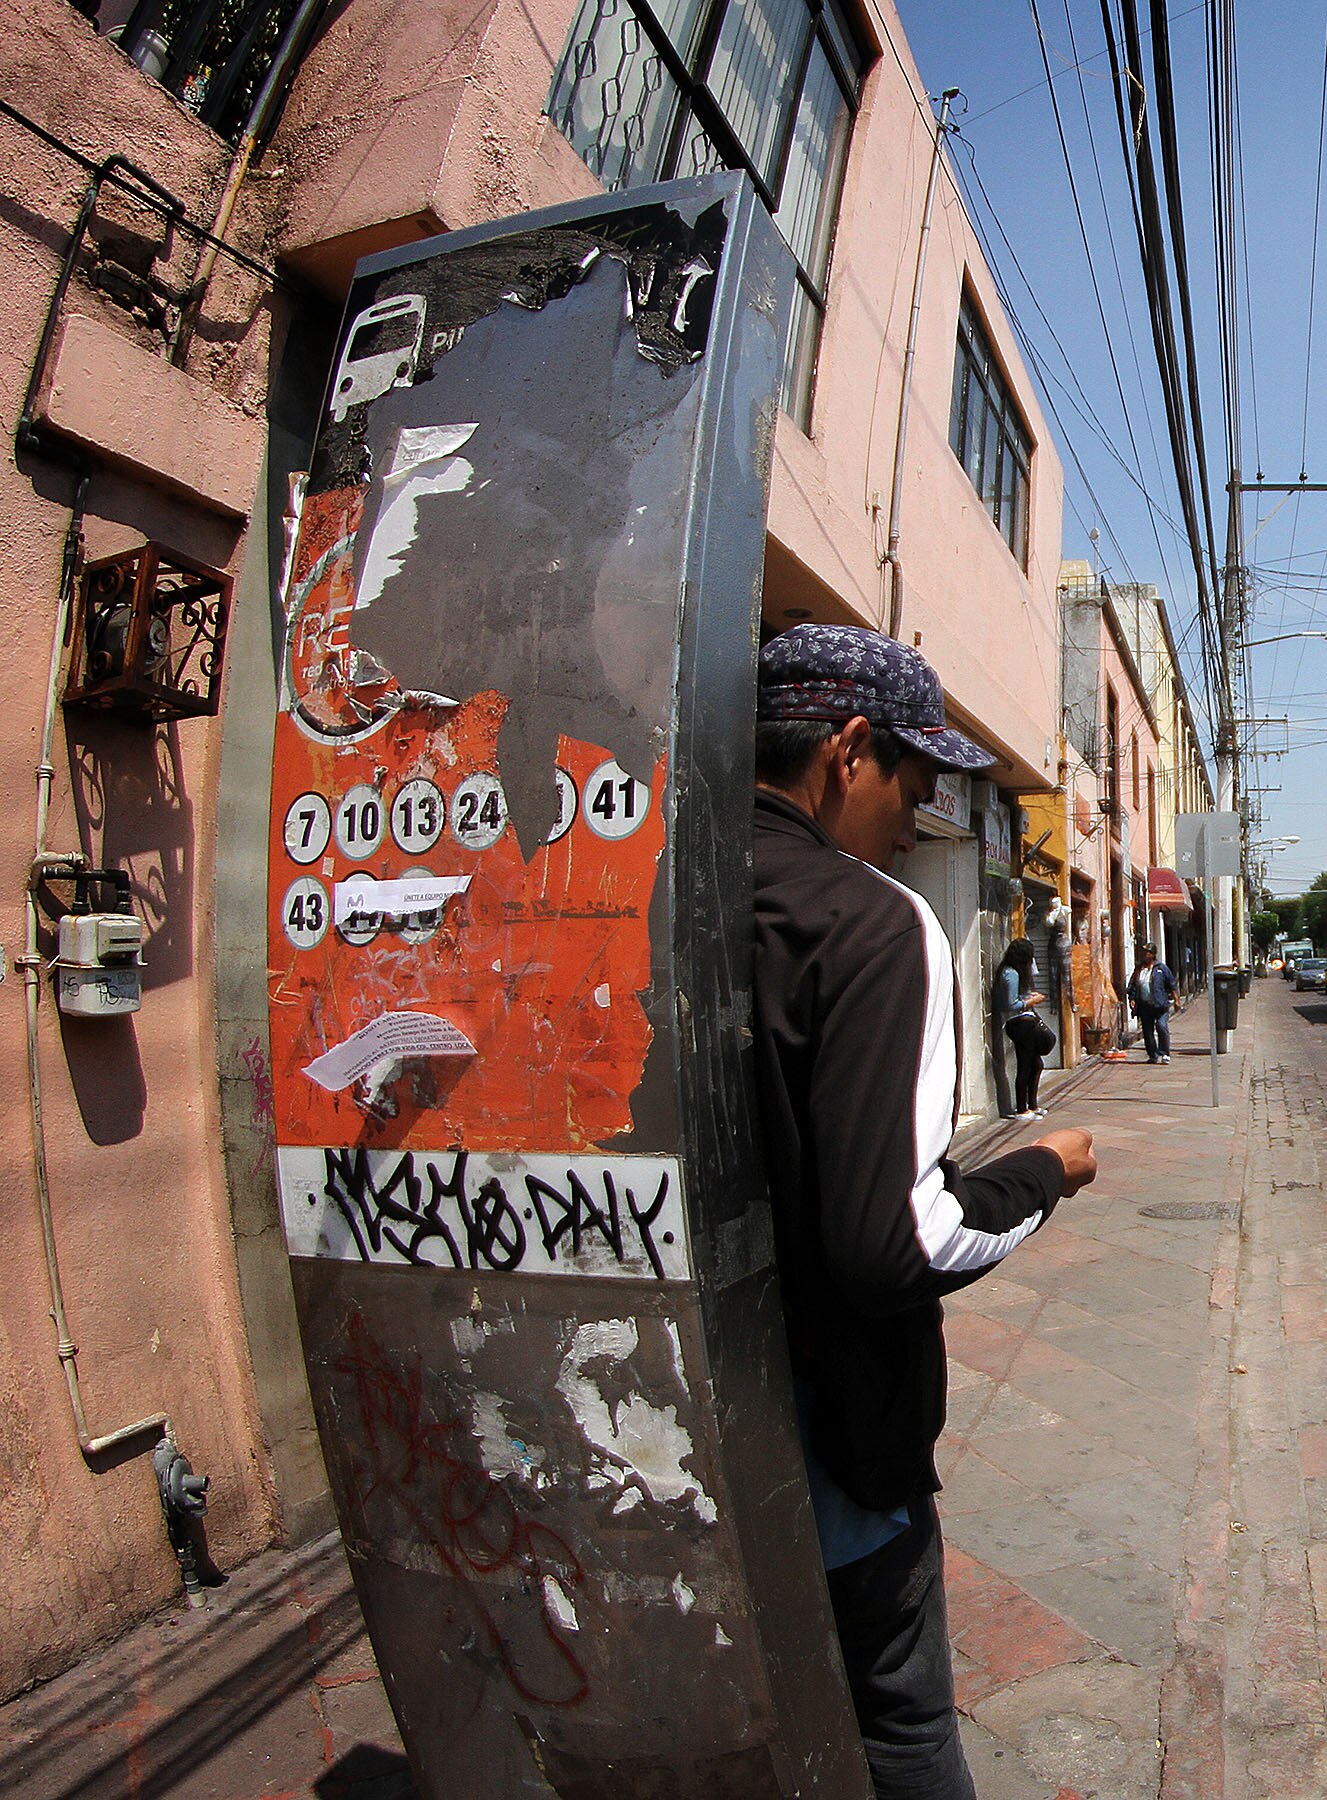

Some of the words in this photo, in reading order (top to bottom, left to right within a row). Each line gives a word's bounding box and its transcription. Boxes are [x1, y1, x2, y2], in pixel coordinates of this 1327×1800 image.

[299, 810, 316, 848] 7
[343, 801, 380, 842] 10
[399, 796, 438, 838] 13
[457, 790, 502, 832] 24
[592, 777, 637, 820] 41
[288, 893, 323, 932] 43
